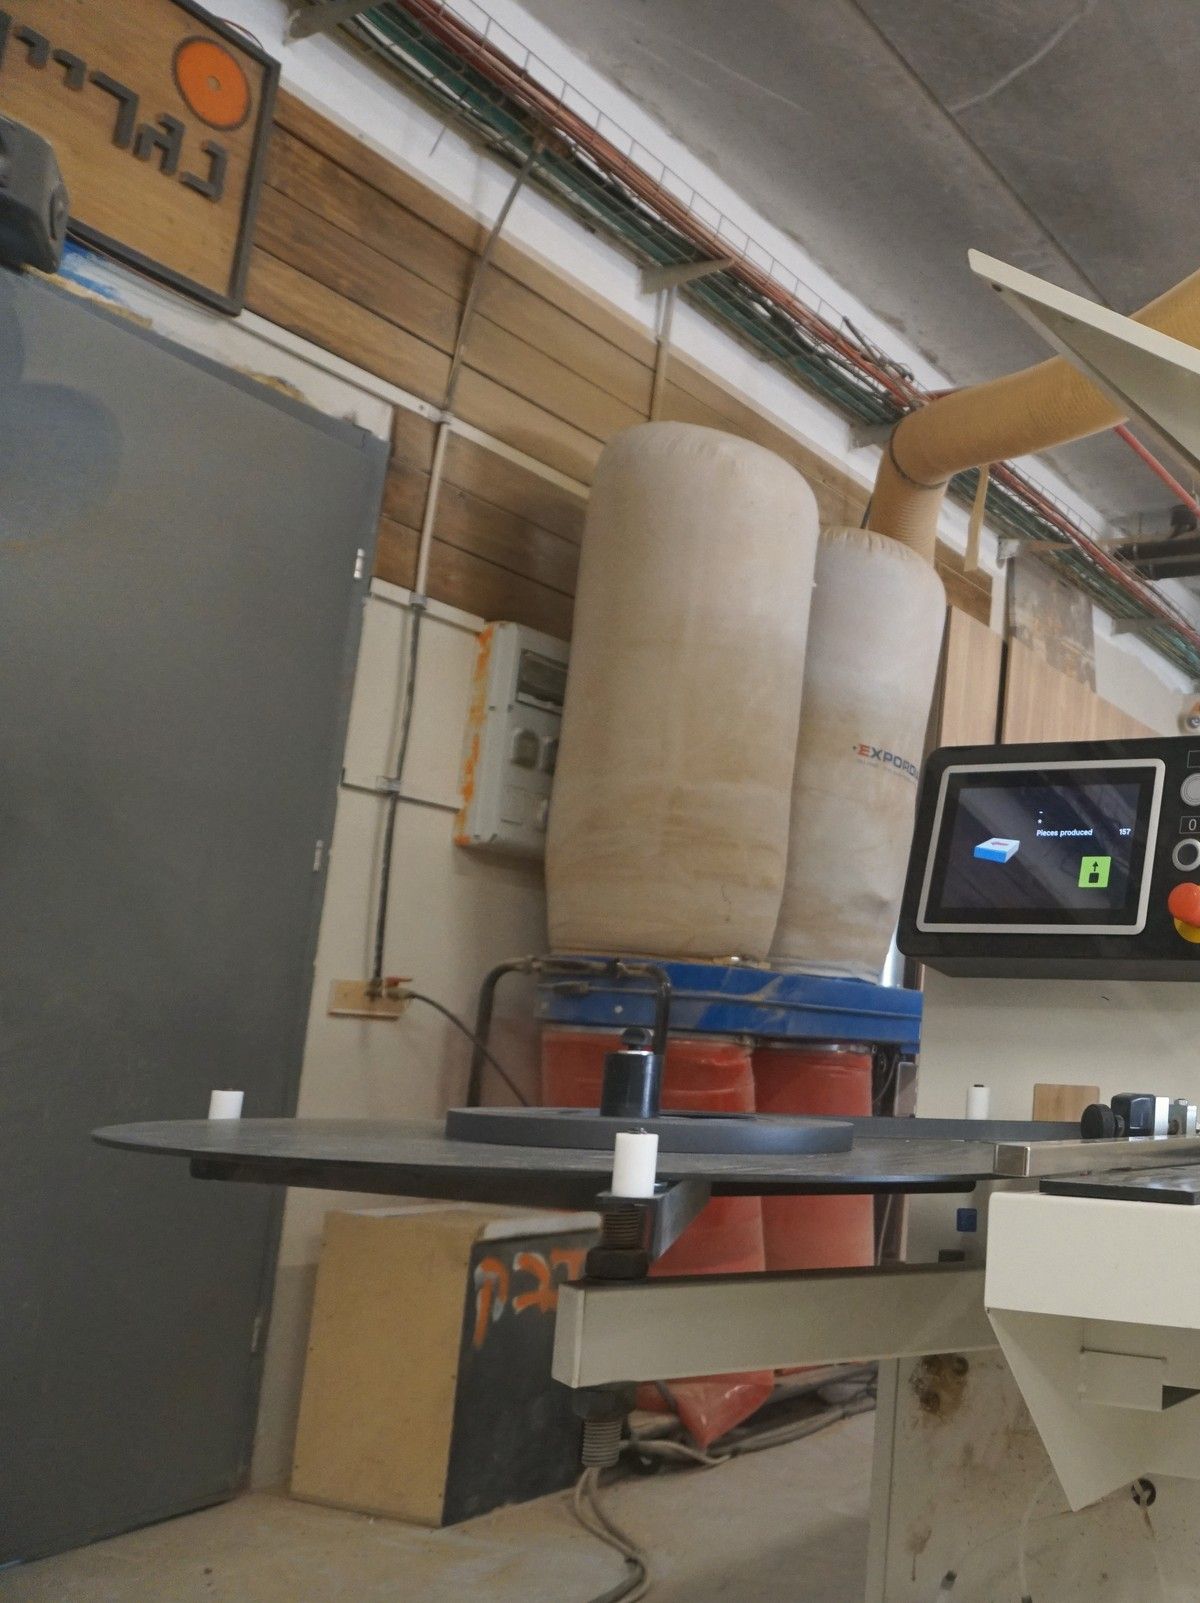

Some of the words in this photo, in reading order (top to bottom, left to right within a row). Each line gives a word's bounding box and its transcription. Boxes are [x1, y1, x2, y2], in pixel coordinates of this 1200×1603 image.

[0, 9, 227, 202] נגריי
[1036, 829, 1059, 837] Pieces
[1060, 828, 1094, 838] produced
[1119, 828, 1132, 836] 157
